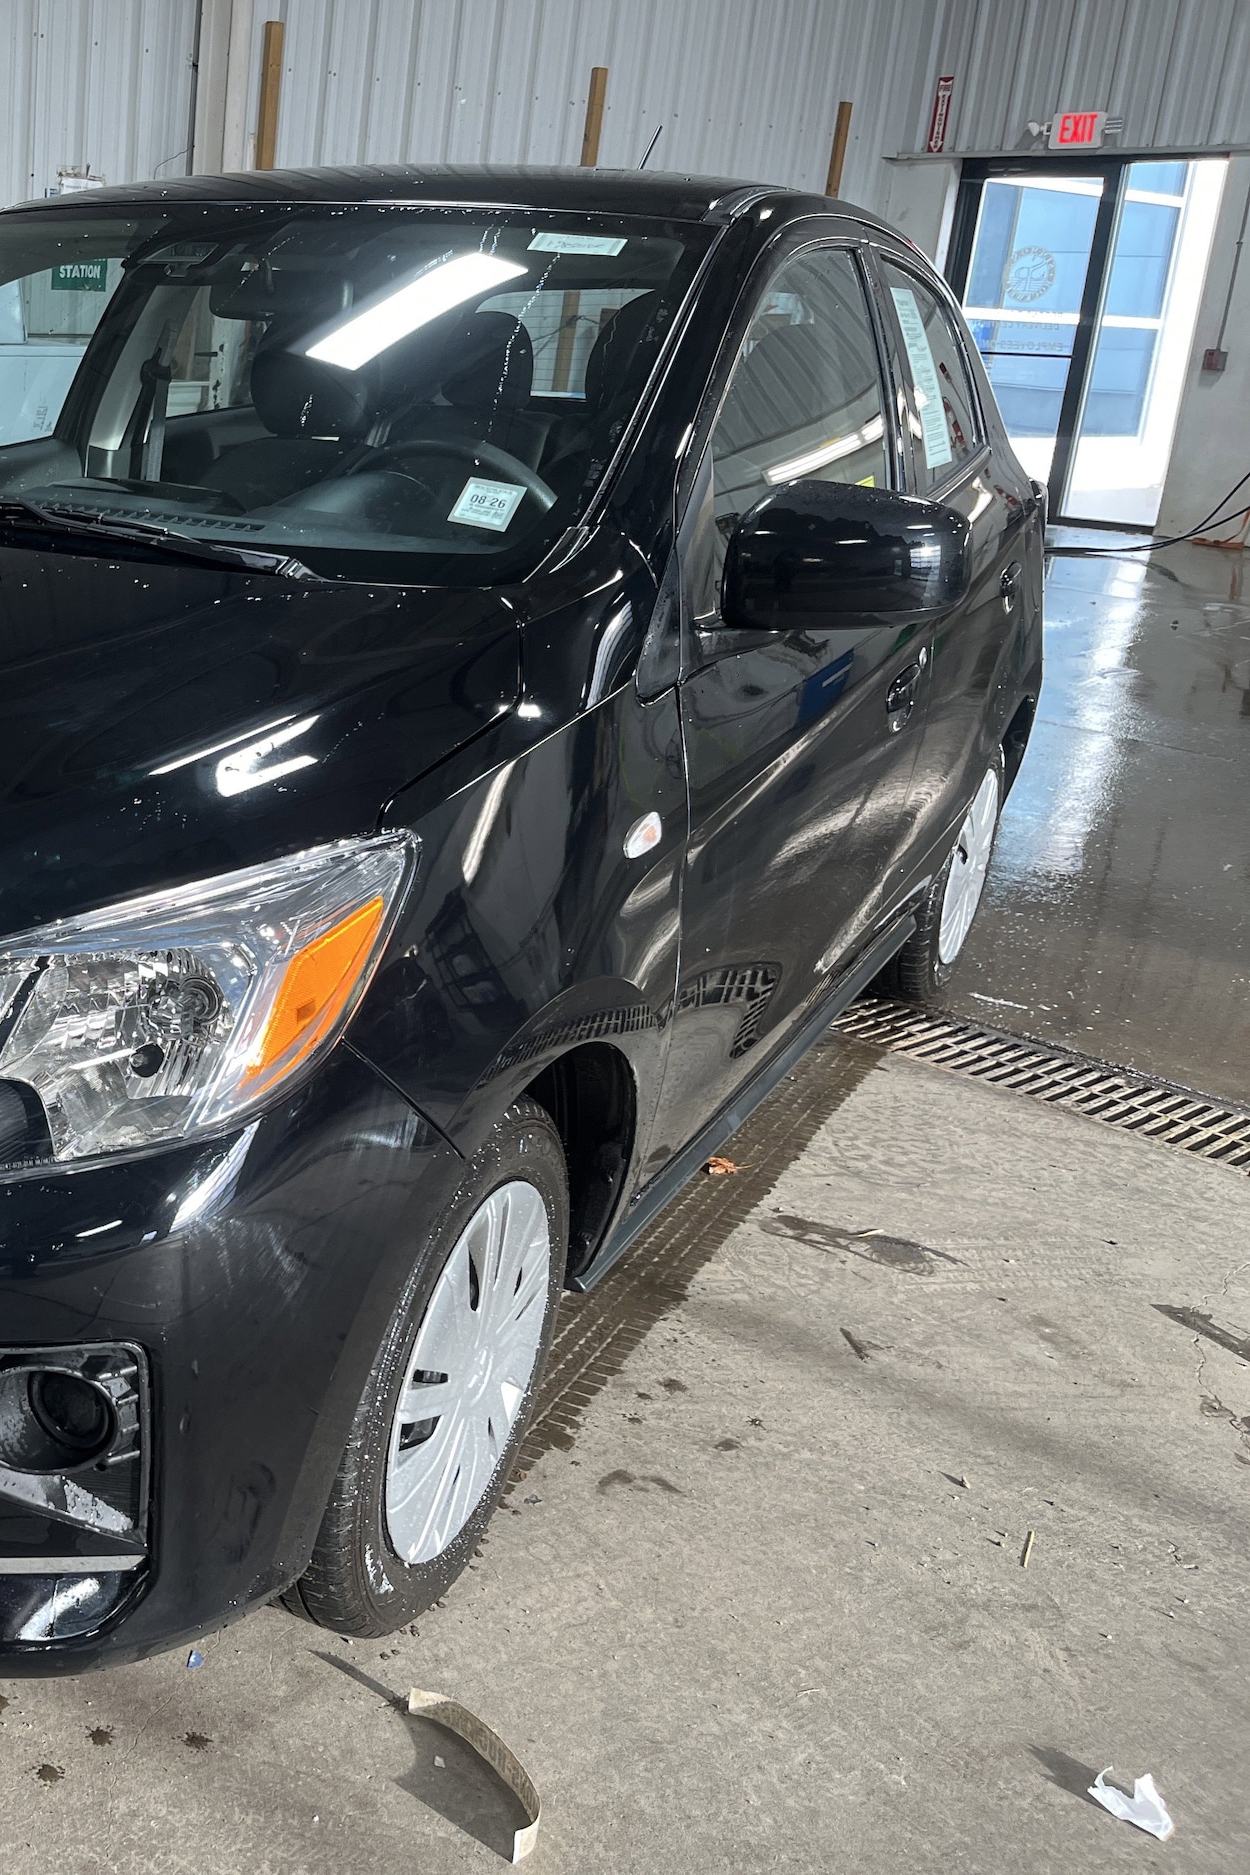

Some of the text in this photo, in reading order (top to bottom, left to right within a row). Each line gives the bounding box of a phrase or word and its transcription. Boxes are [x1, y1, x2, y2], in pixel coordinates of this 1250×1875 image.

[1058, 112, 1098, 144] EXIT
[59, 265, 101, 279] STATION
[470, 494, 507, 508] 08 26
